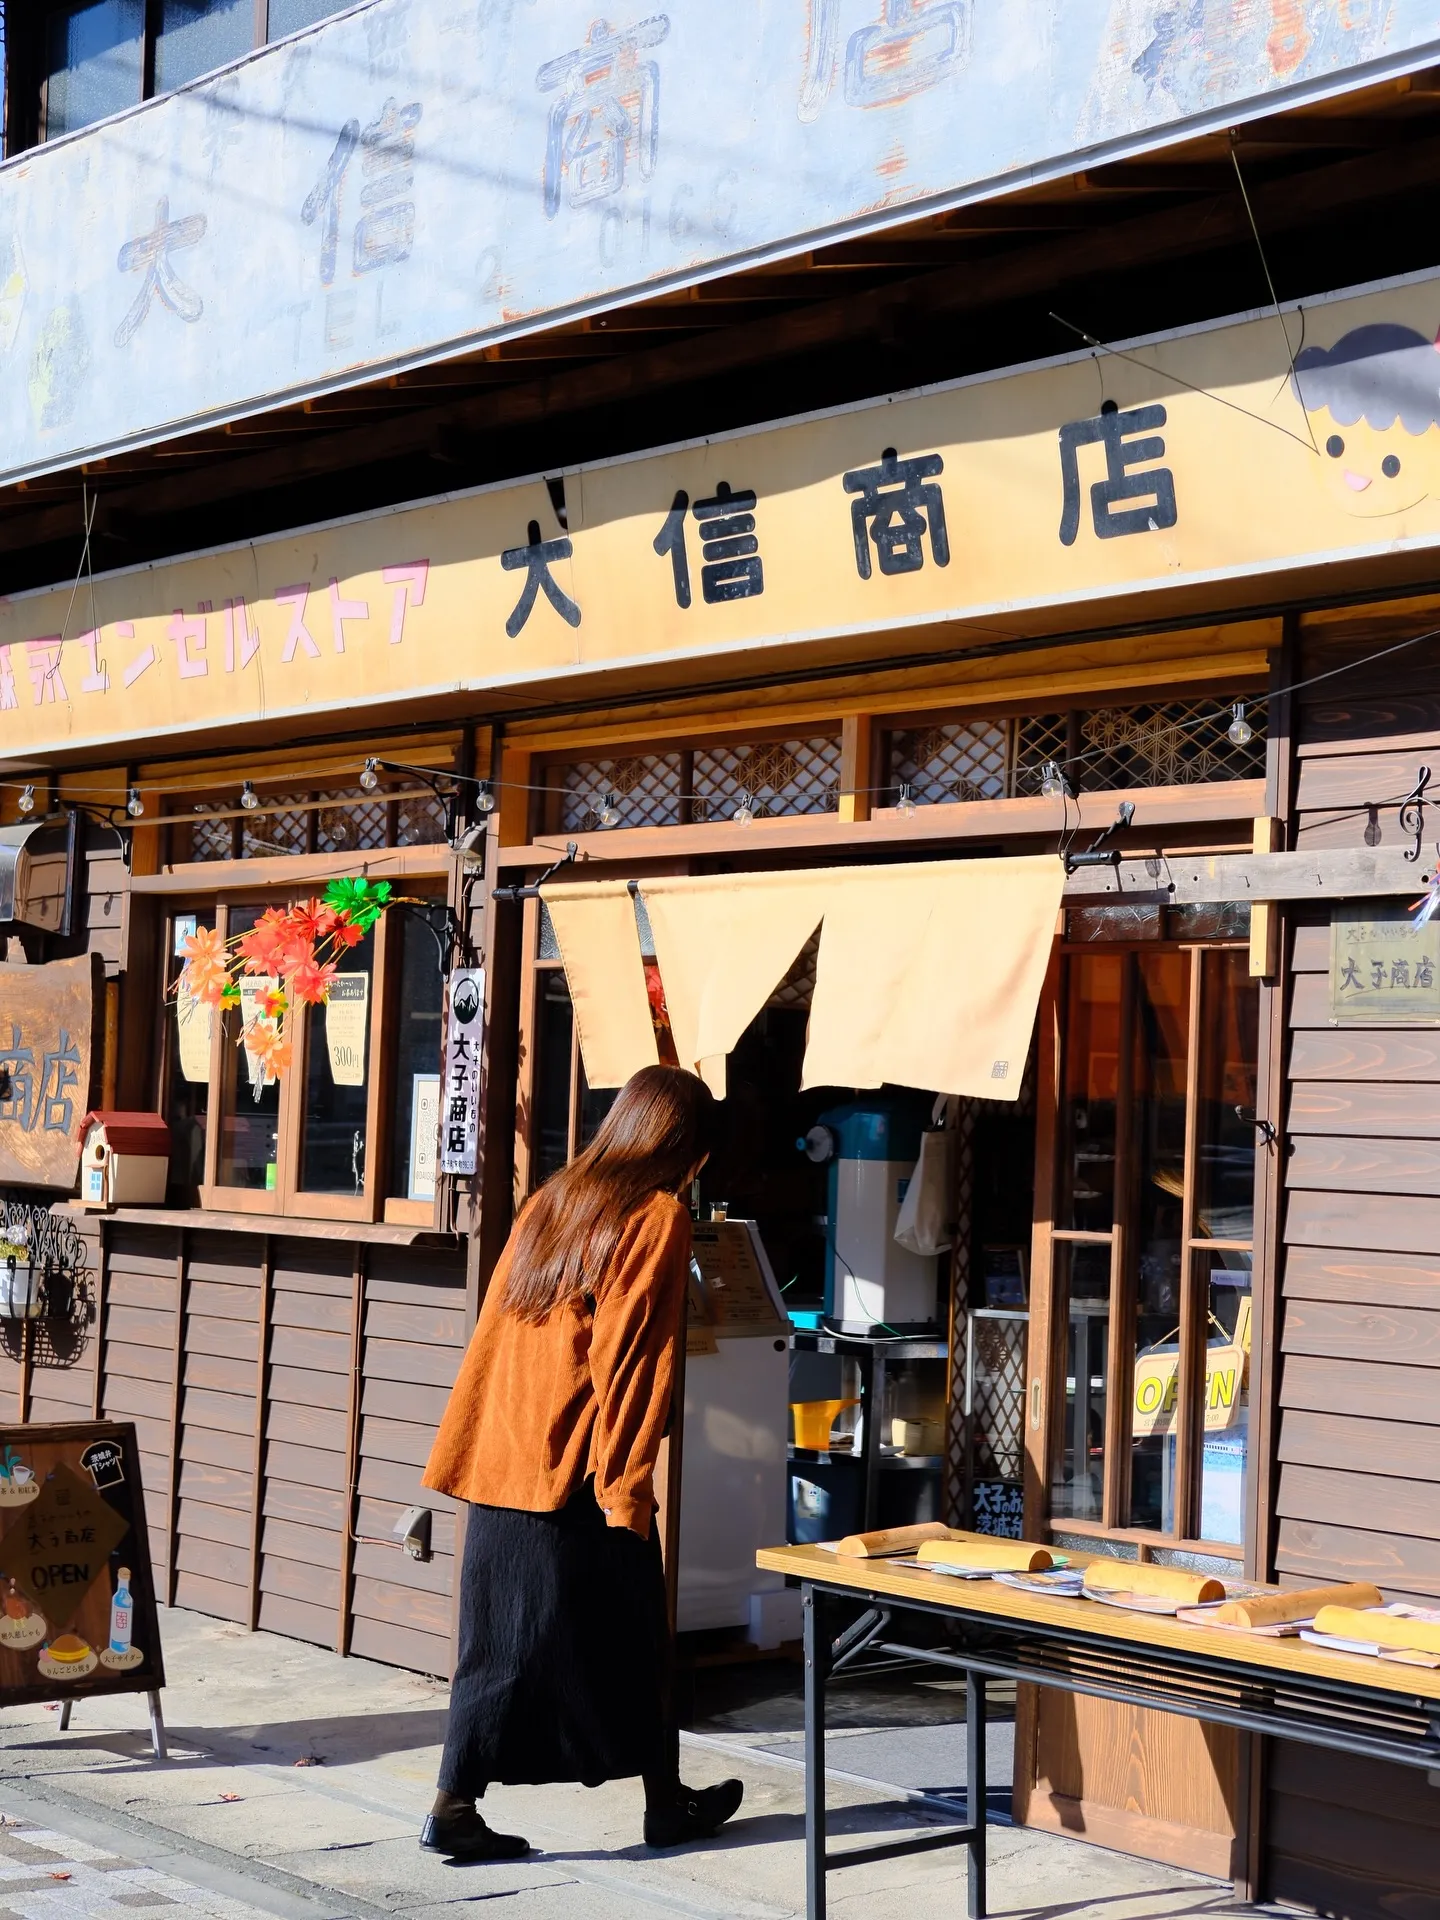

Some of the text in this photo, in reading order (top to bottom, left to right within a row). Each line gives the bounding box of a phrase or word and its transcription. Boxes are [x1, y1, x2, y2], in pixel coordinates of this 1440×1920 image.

[501, 399, 1178, 639] 大信商店
[1339, 955, 1437, 991] 大子商店
[446, 1032, 470, 1153] 大子商店
[469, 1041, 480, 1133] 大子のいいもの
[90, 1449, 112, 1463] 茨城弁
[91, 1457, 116, 1473] Tシャツ
[30, 1563, 90, 1591] OPEN
